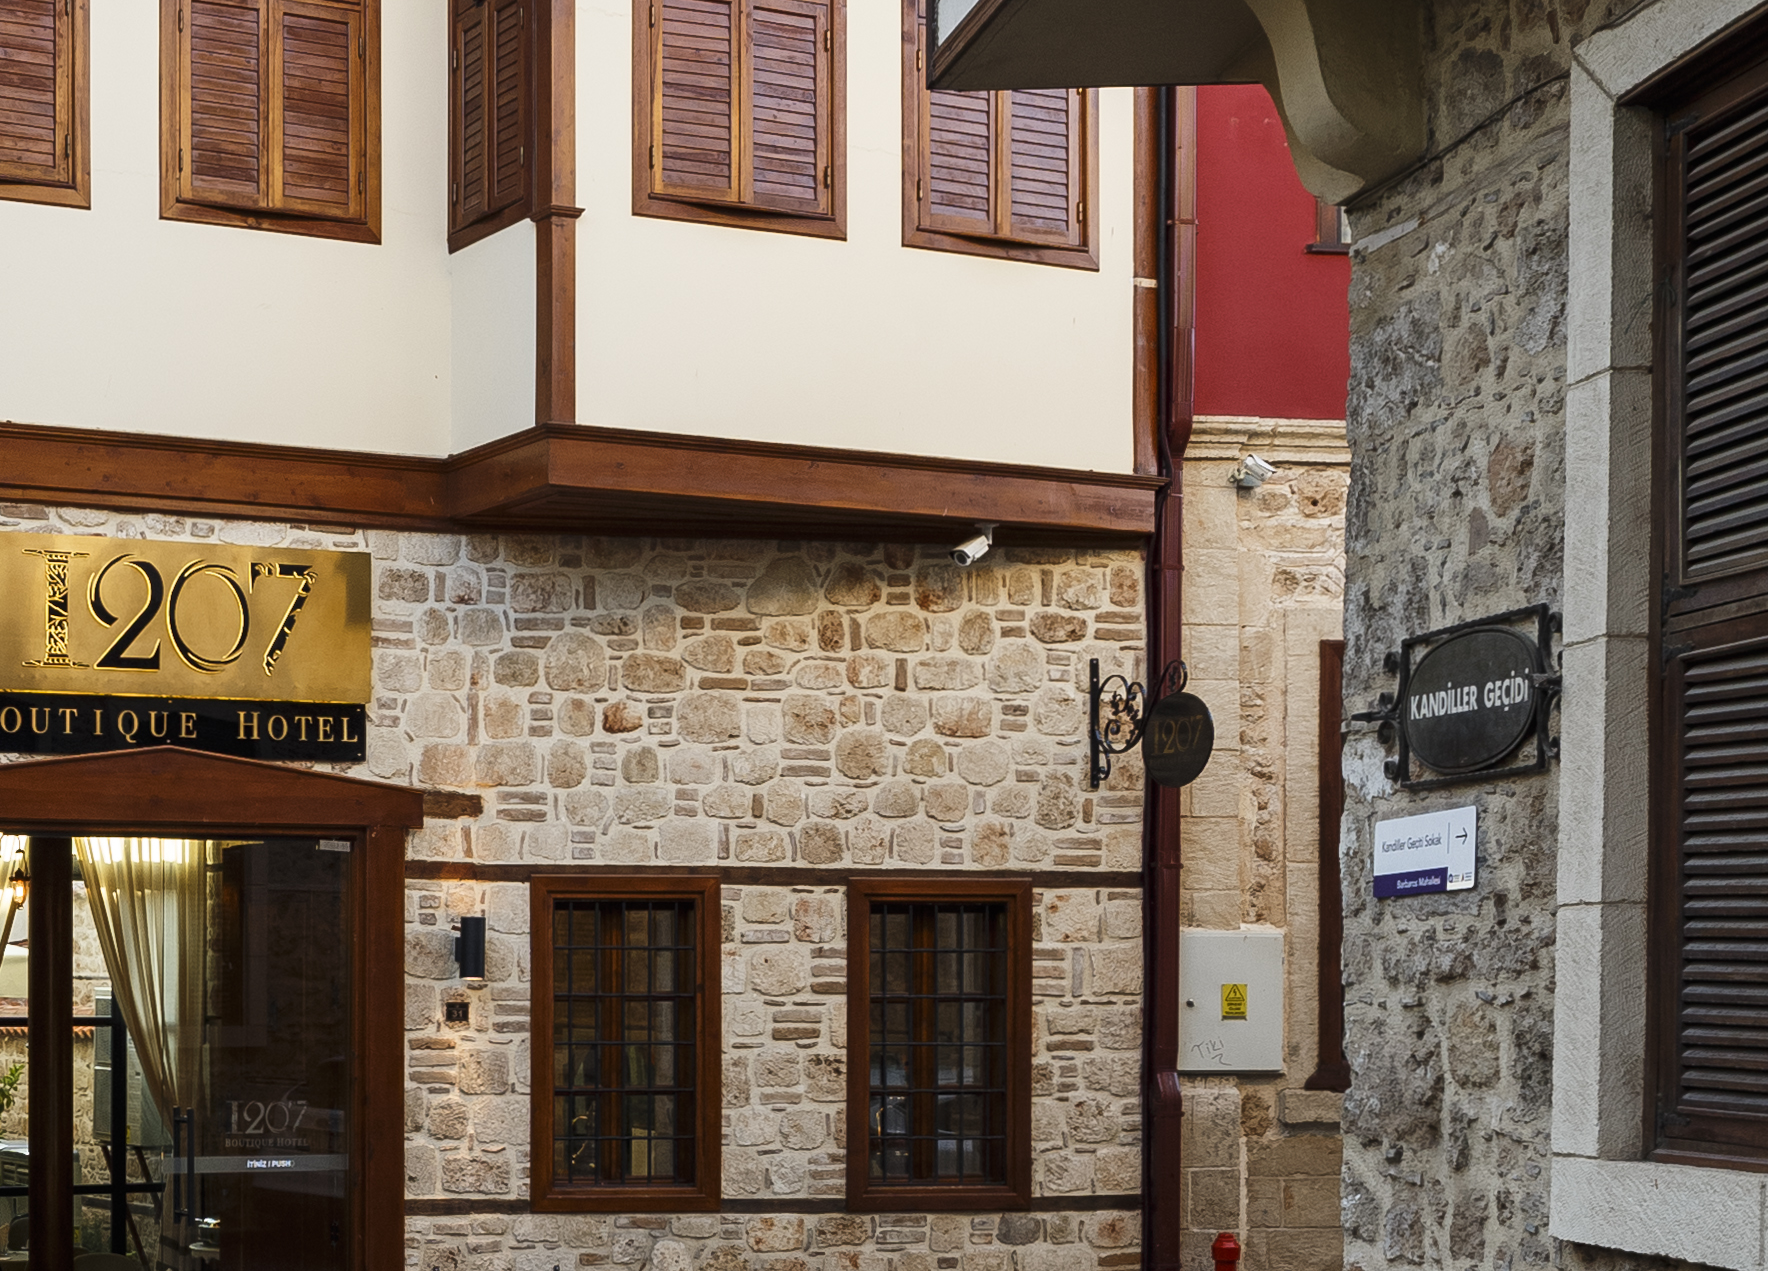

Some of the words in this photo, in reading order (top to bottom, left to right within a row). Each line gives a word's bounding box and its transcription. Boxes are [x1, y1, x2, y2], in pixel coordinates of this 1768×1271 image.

[22, 549, 318, 676] 1207
[1410, 681, 1478, 720] KANDİLLER
[1483, 667, 1529, 711] GEÇİDİ
[237, 711, 358, 742] HOTEL
[1150, 715, 1204, 756] 1207
[1381, 838, 1406, 853] Kandiller
[1424, 833, 1442, 848] Sokak
[225, 1099, 310, 1134] 1207
[271, 1159, 292, 1168] PUSH
